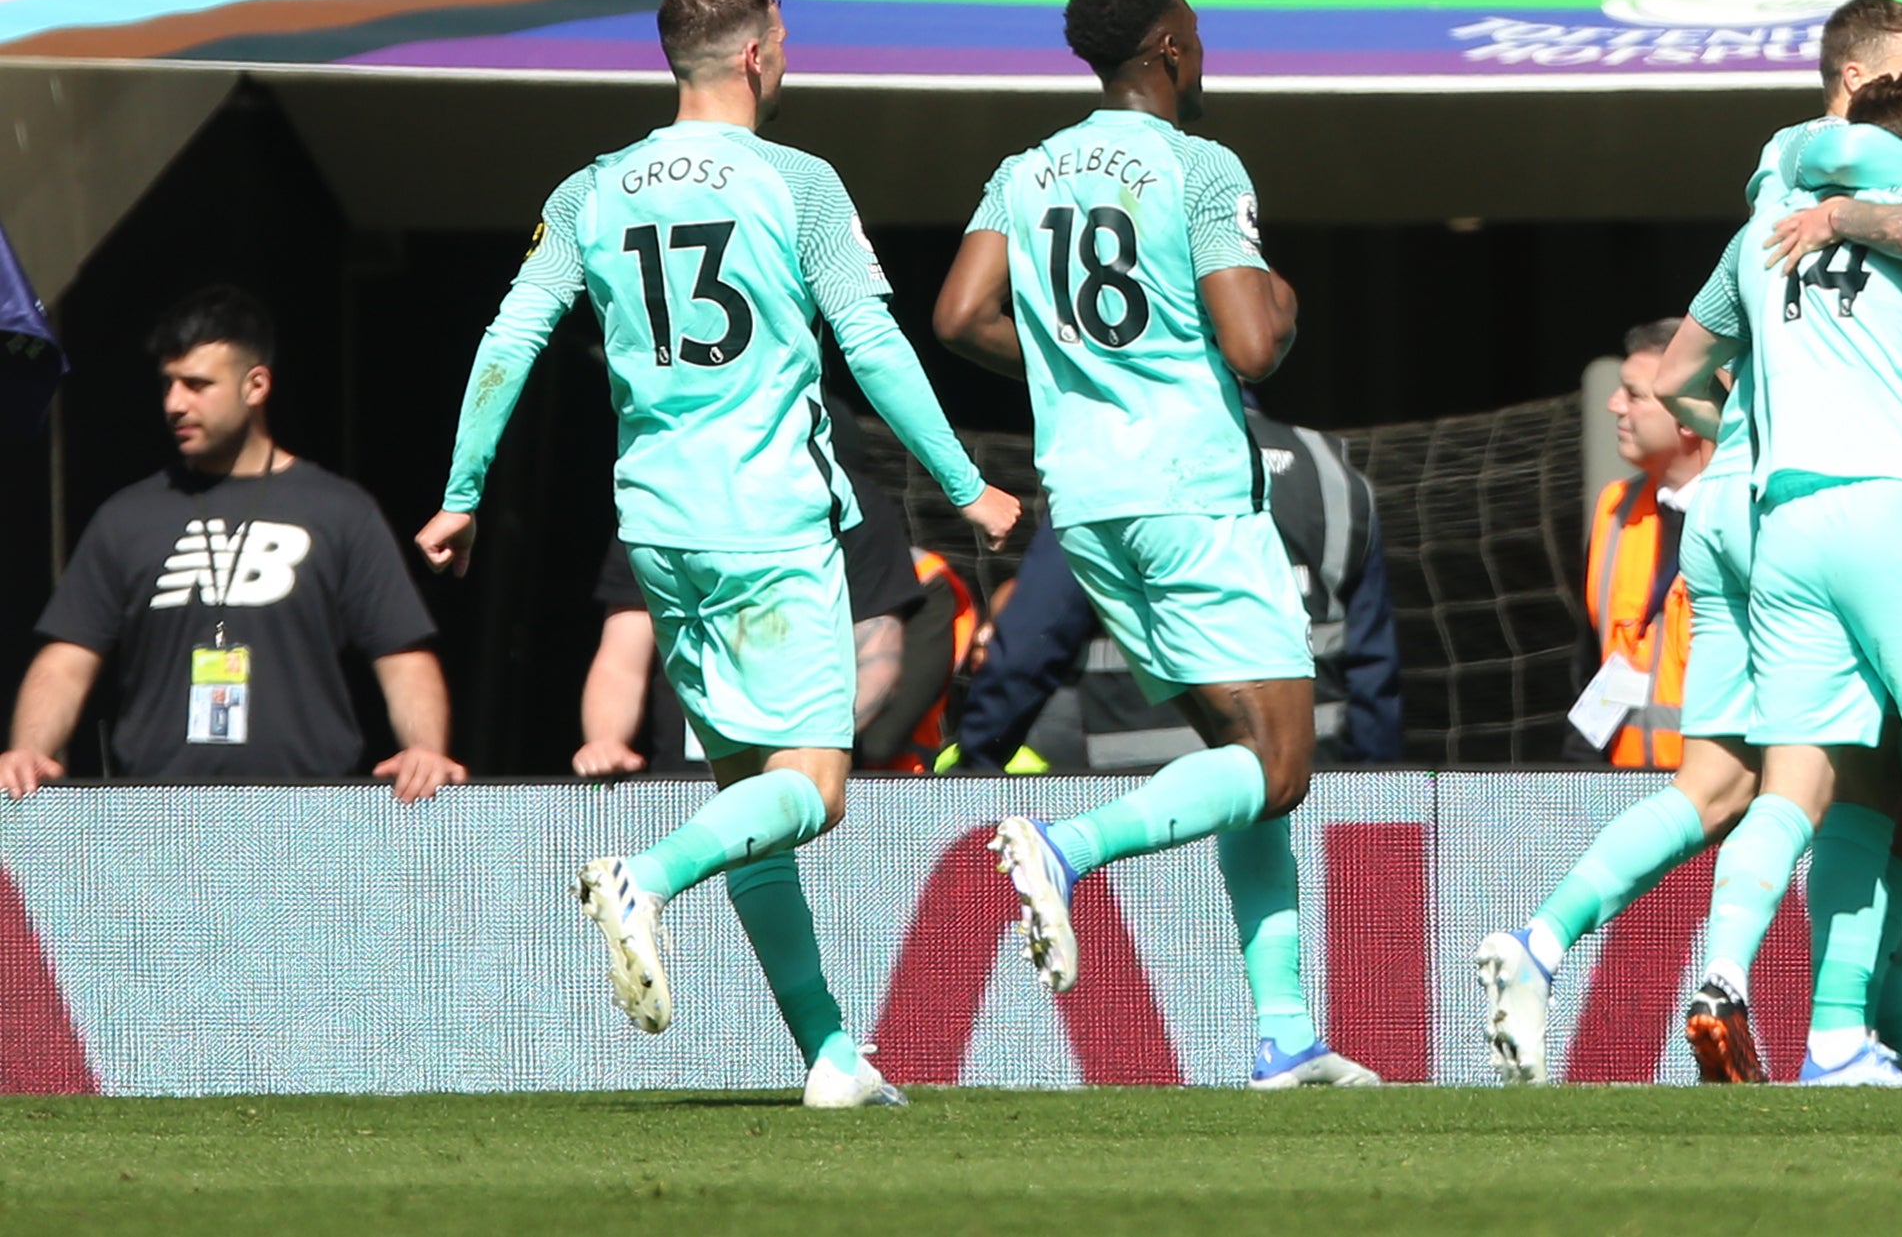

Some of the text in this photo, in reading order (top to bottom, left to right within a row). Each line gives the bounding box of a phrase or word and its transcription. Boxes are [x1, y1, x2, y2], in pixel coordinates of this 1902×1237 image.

[1450, 16, 1830, 44] TOTTENH
[1463, 42, 1827, 65] HOTSPU
[622, 157, 734, 195] GROSS
[1034, 147, 1158, 198] WELBECK
[622, 220, 754, 367] 13
[1039, 206, 1150, 349] 18
